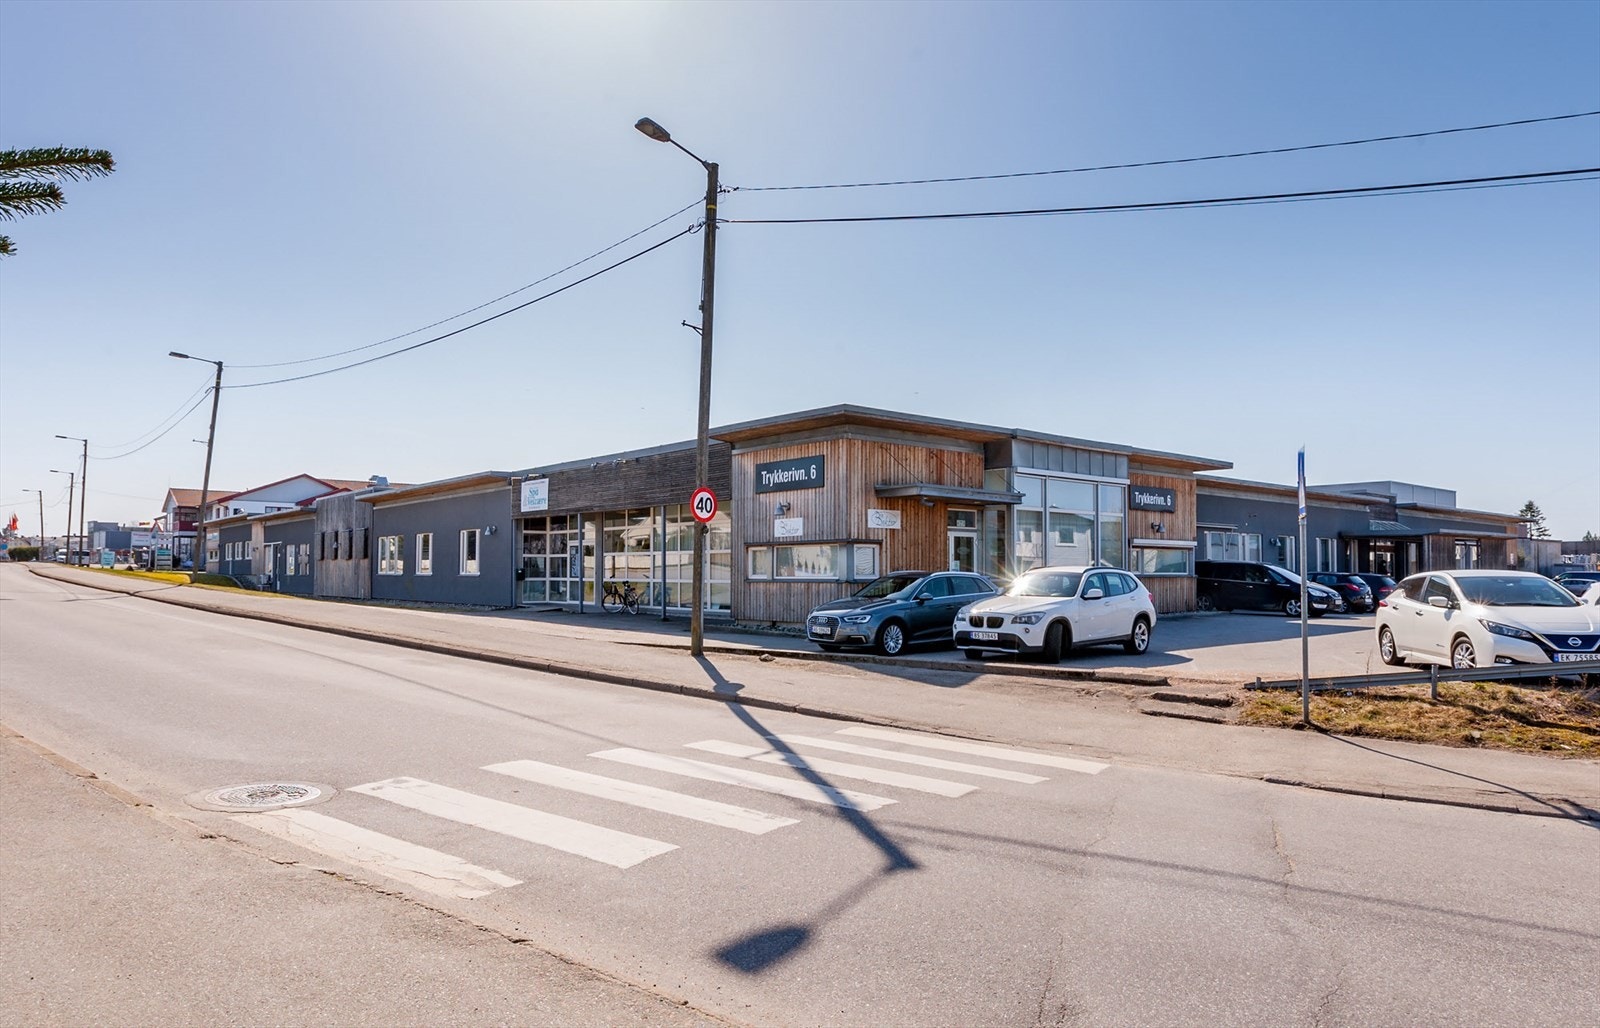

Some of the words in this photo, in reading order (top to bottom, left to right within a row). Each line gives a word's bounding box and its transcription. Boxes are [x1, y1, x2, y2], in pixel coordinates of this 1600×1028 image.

[761, 467, 808, 487] Trykkerivn.
[810, 464, 817, 480] 6
[696, 496, 713, 514] 40
[1134, 491, 1166, 506] Trykkerivn.
[1166, 495, 1172, 506] 6
